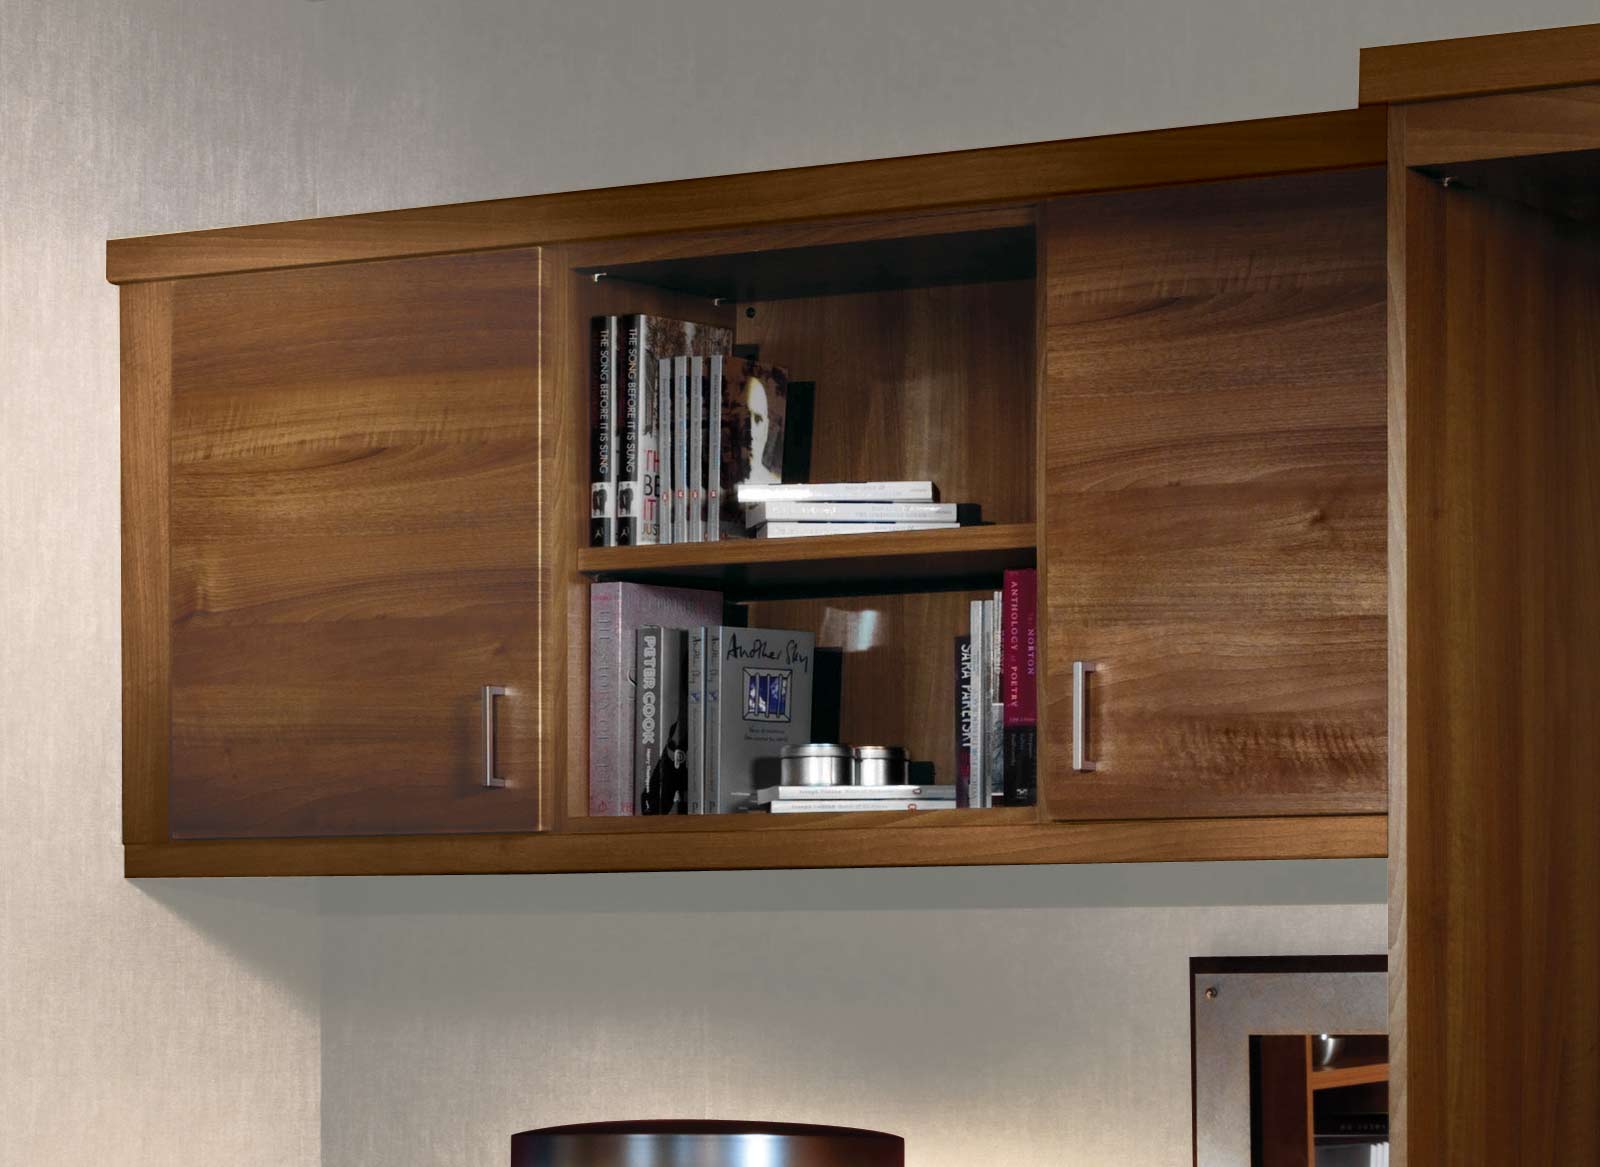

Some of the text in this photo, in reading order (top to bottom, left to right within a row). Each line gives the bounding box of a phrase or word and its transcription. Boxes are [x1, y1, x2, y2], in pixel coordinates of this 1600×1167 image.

[599, 329, 609, 475] THE SONG BEFORE IT IS SUNG
[625, 328, 638, 473] THE SONG BEFORE IT IS SUNG
[646, 449, 660, 473] TH
[643, 497, 657, 521] IT
[1010, 580, 1019, 651] ANTHOLOGY
[727, 632, 809, 673] Another Sky
[960, 643, 972, 680] SARA
[1026, 628, 1036, 676] NORTON
[642, 635, 657, 745] PETER COOK
[1010, 665, 1019, 708] POETRY
